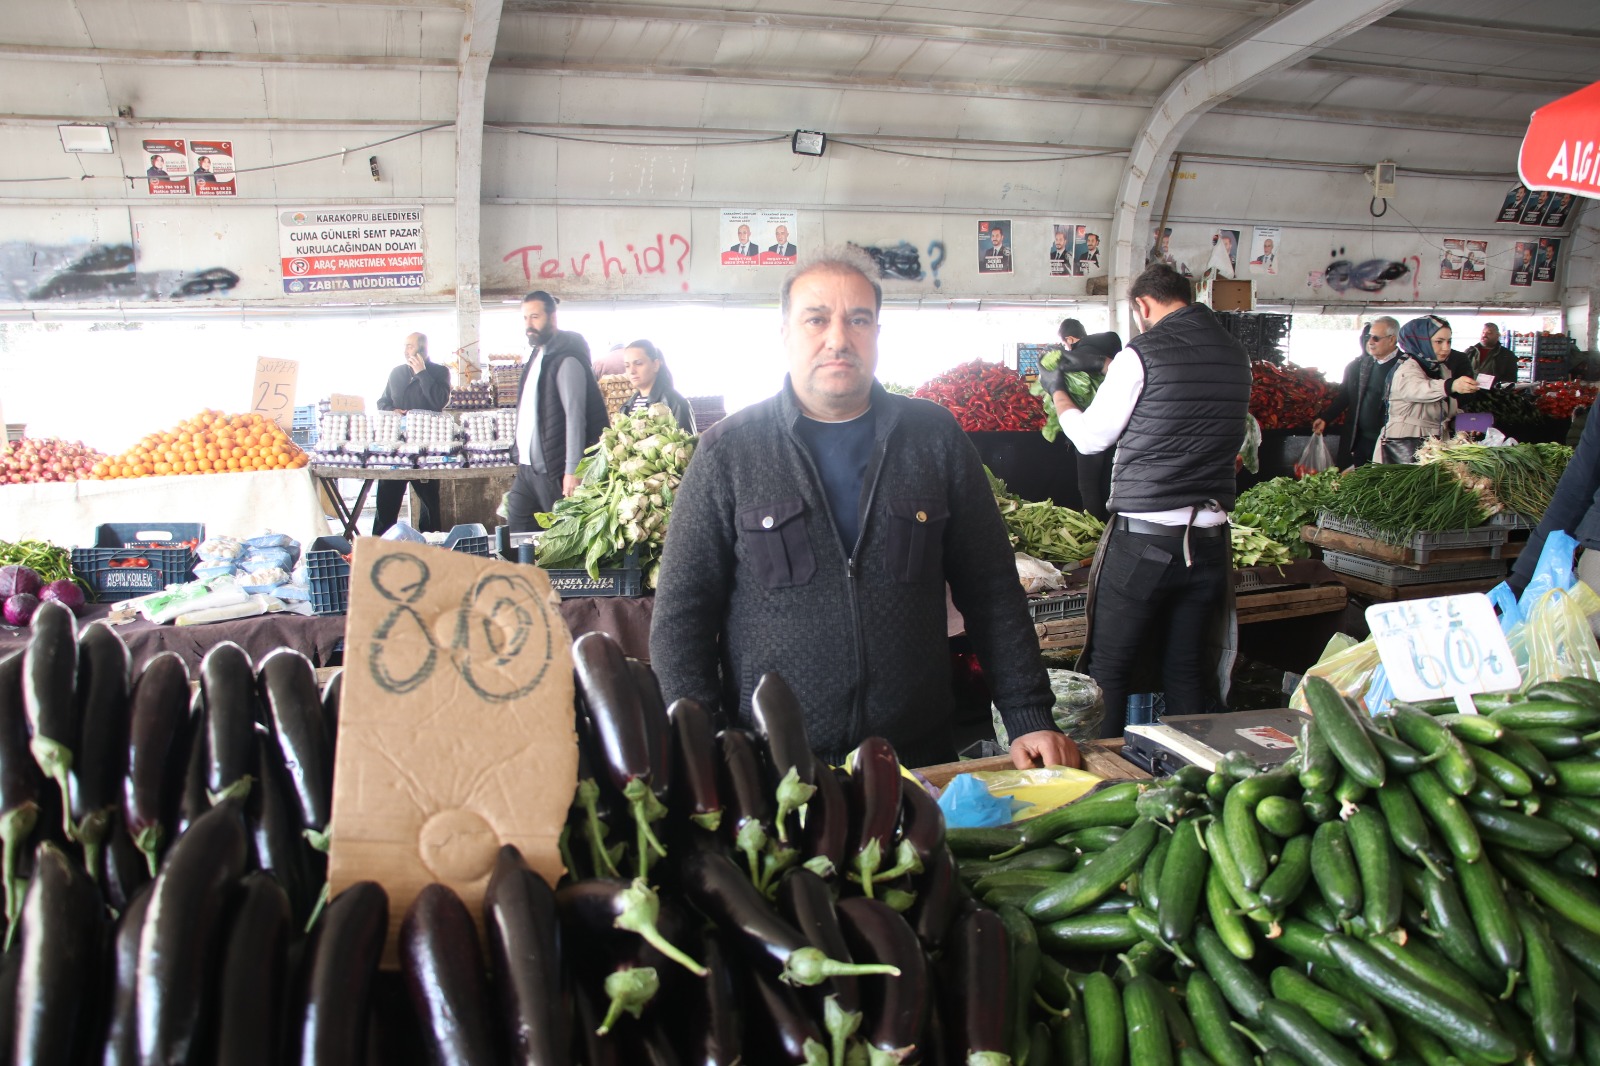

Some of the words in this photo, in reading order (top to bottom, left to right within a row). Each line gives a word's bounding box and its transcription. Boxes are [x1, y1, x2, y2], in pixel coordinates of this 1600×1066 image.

[316, 212, 369, 223] KARAKÖPRÜ
[371, 211, 420, 221] BELEDİYESİ
[290, 231, 318, 242] CUMA
[321, 228, 361, 240] GÜNLERİ
[363, 229, 387, 239] SEMT
[296, 242, 382, 255] KURULACAĞINDAN
[385, 242, 417, 251] DOLAYI
[313, 259, 336, 271] ARAÇ
[338, 257, 387, 269] PARKETMEK
[309, 280, 350, 291] ZABITA
[353, 275, 424, 289] MÜDÜRLÜĞÜ
[255, 381, 291, 411] 25
[107, 573, 126, 582] AYDIN
